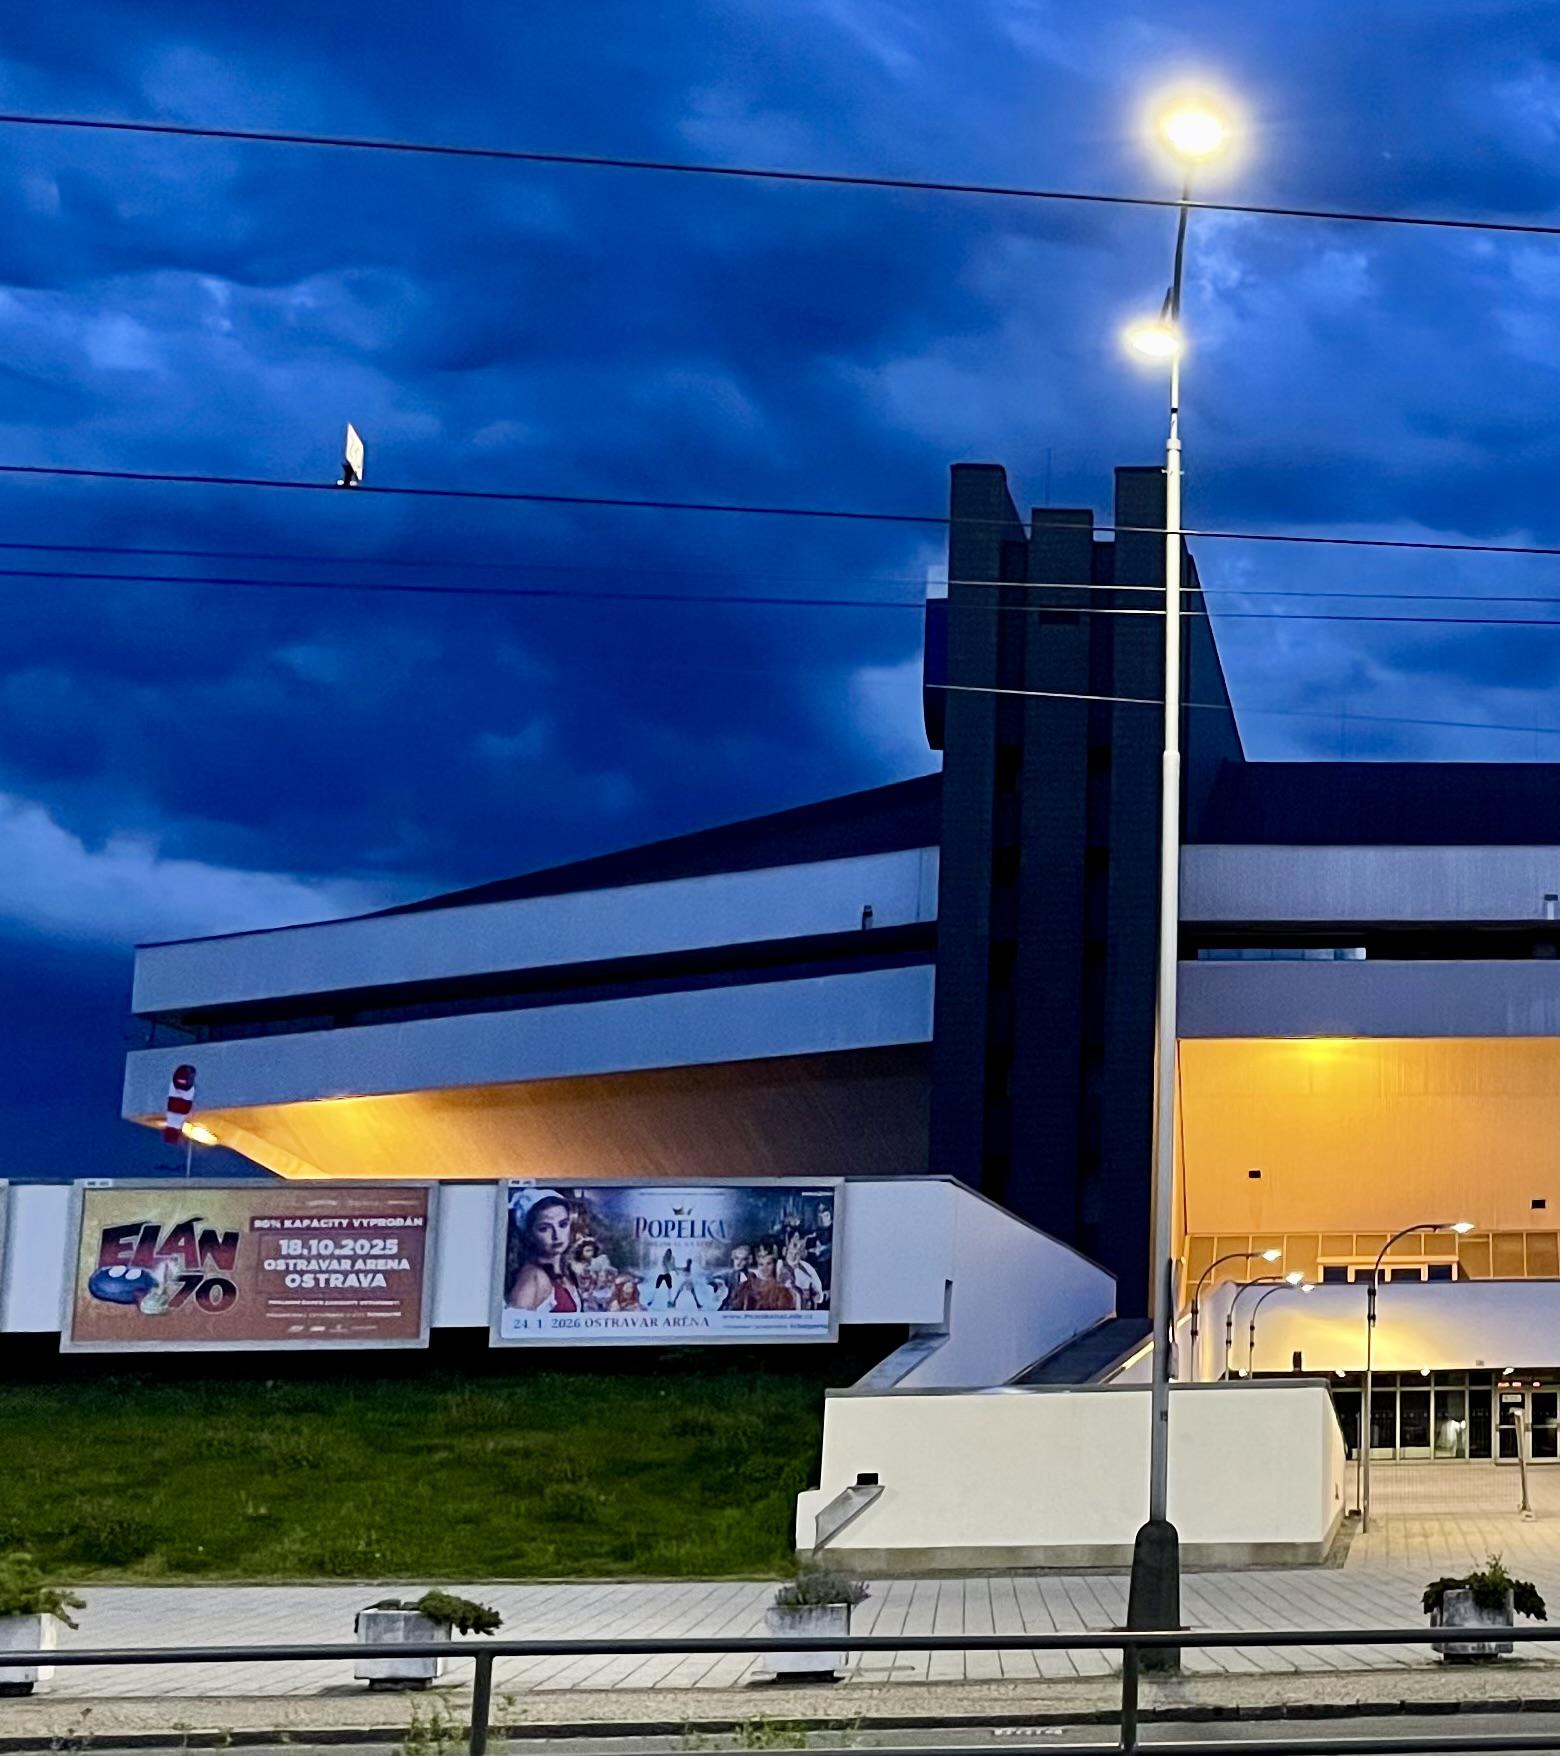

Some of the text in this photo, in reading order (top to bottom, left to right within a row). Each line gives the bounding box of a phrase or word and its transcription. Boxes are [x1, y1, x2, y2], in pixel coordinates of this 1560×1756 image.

[284, 1218, 349, 1228] KAPACITY
[352, 1216, 423, 1227] VYPRODÁN
[634, 1217, 731, 1243] POPELKA
[279, 1239, 399, 1256] 18.10.2025
[263, 1258, 411, 1270] OSTRAVAR ARENA
[285, 1273, 387, 1288] OSTRAVA
[167, 1274, 238, 1314] 70
[551, 1318, 581, 1329] 2026
[584, 1317, 658, 1329] OSTRAVAR
